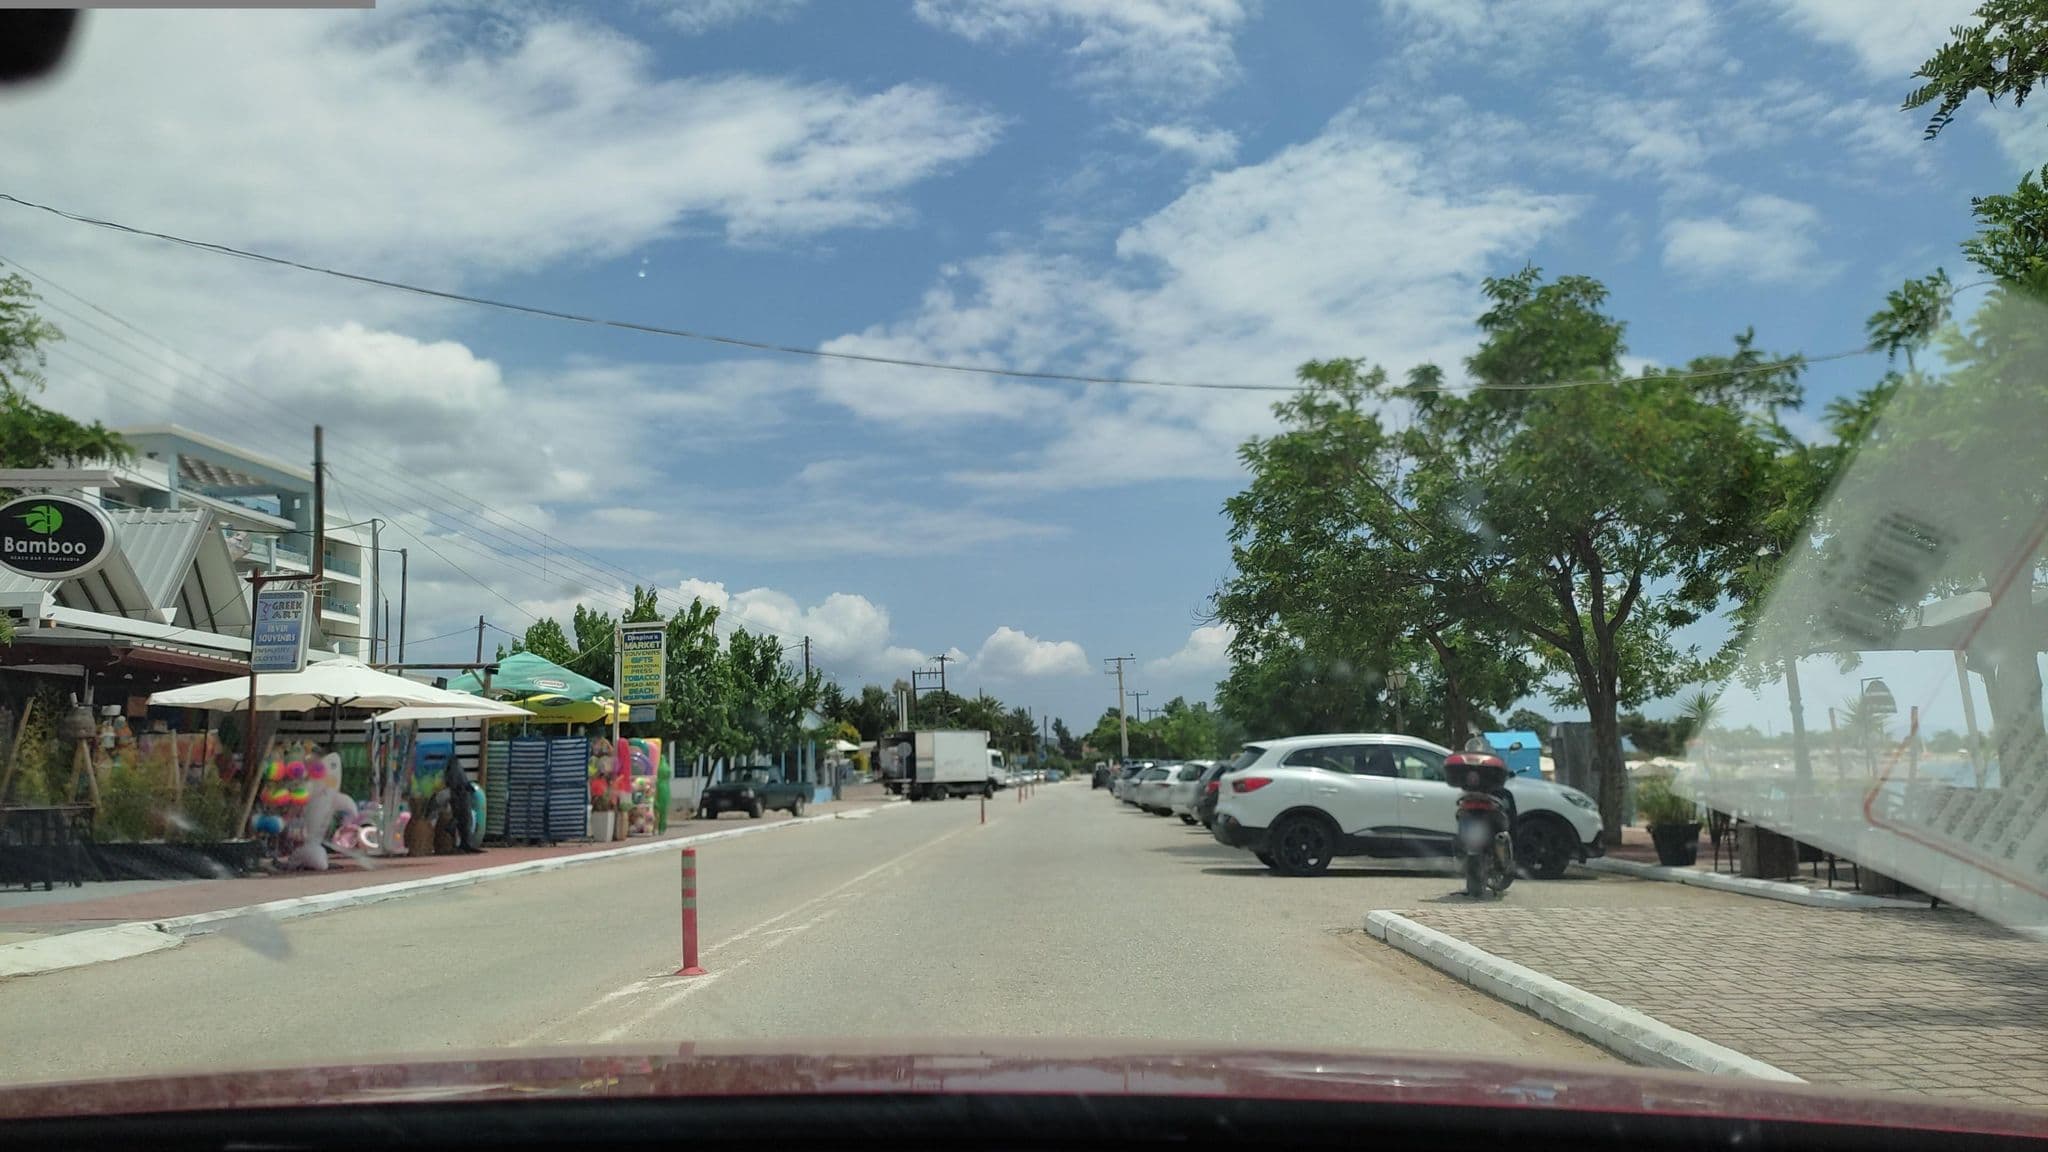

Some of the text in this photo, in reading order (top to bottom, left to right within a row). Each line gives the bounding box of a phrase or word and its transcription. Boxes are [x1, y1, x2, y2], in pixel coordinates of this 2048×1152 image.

[4, 536, 87, 555] Bamboo
[272, 601, 302, 610] GREEK
[272, 610, 301, 618] ART
[624, 641, 660, 650] MARKET
[629, 687, 655, 695] BEACH
